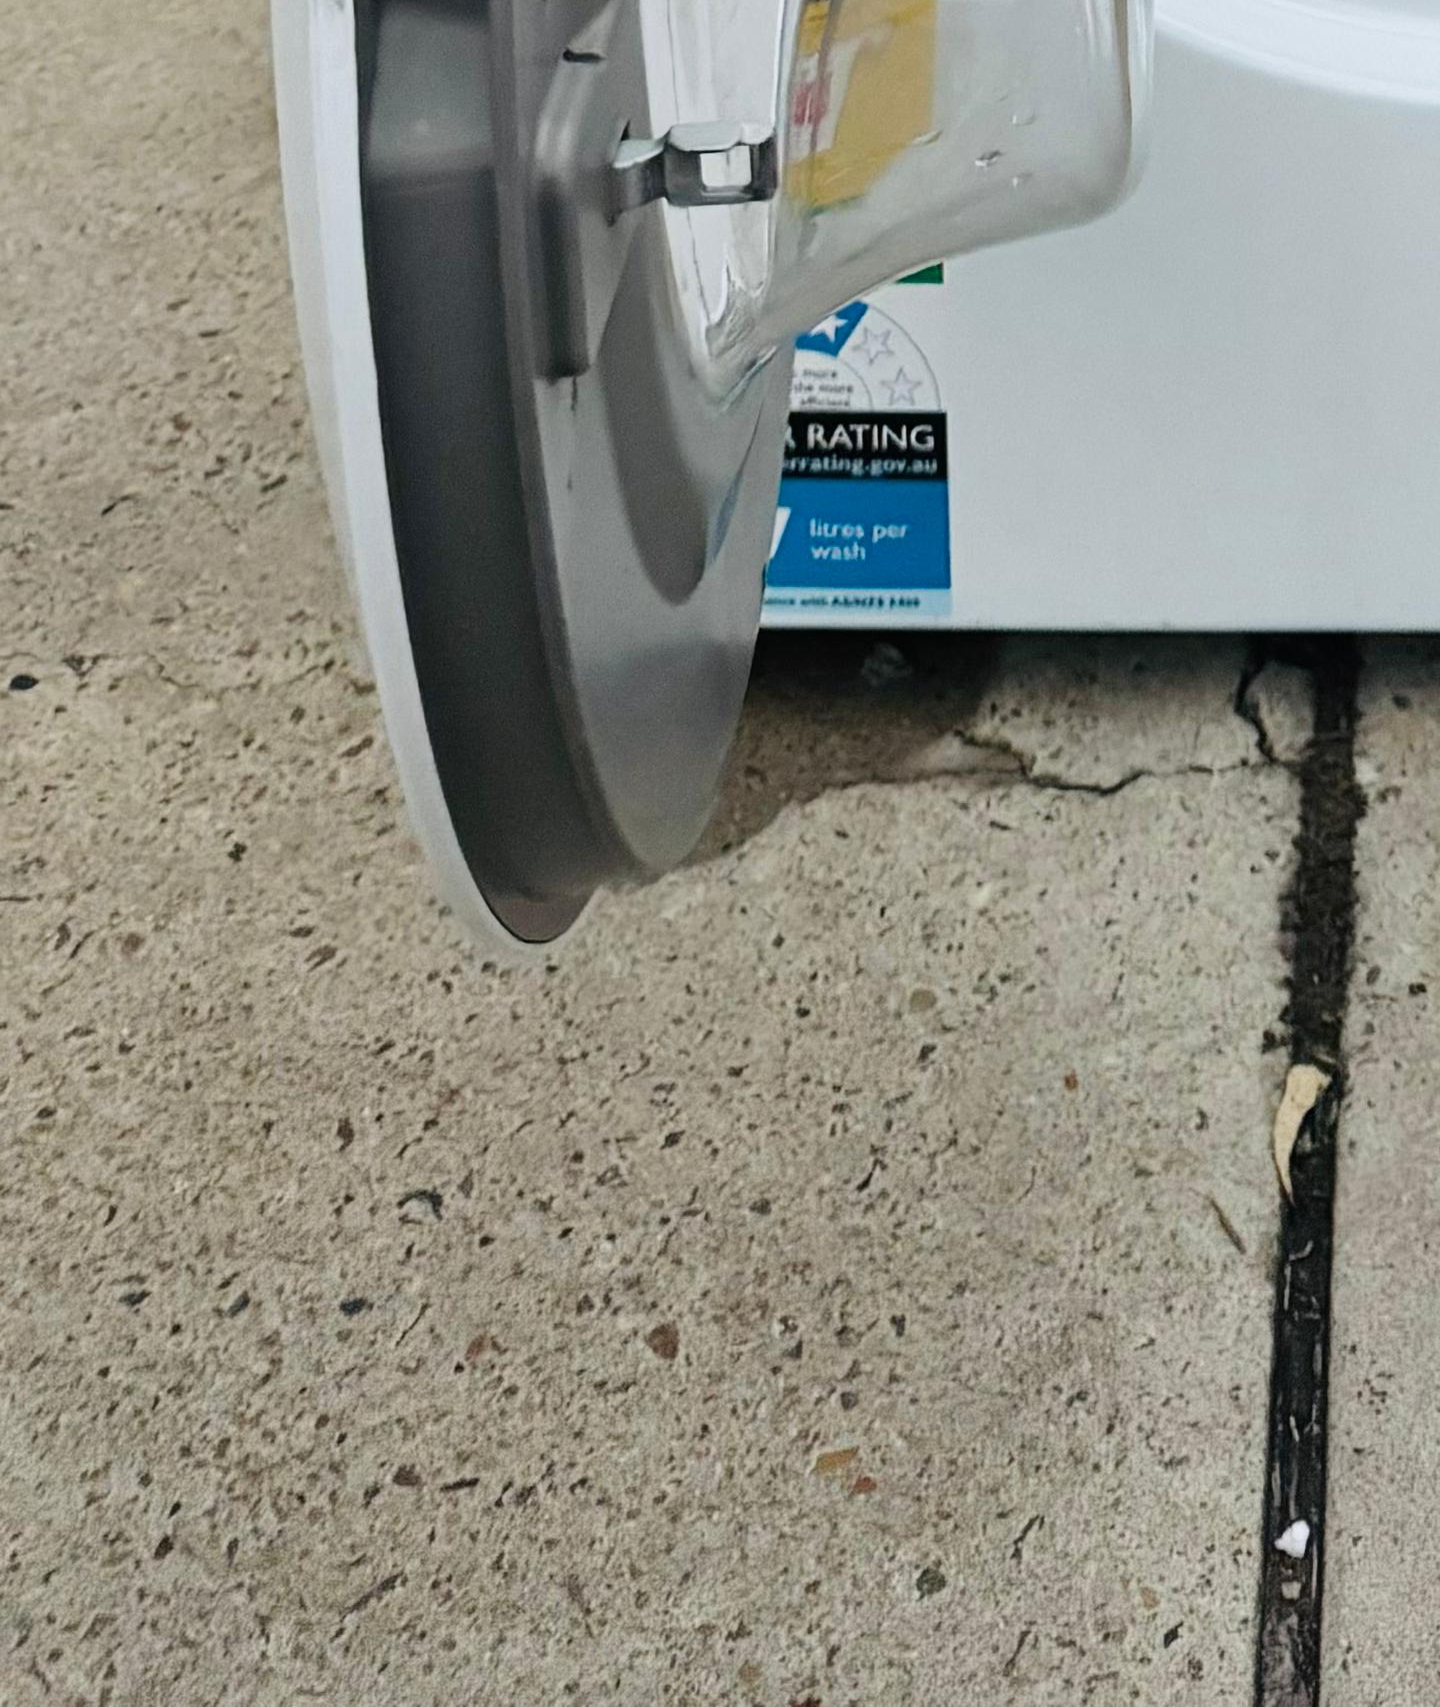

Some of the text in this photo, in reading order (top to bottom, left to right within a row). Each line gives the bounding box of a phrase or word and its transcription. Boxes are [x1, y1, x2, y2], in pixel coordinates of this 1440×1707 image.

[807, 423, 935, 452] RATING
[809, 518, 908, 544] litres per
[810, 541, 865, 561] wash
